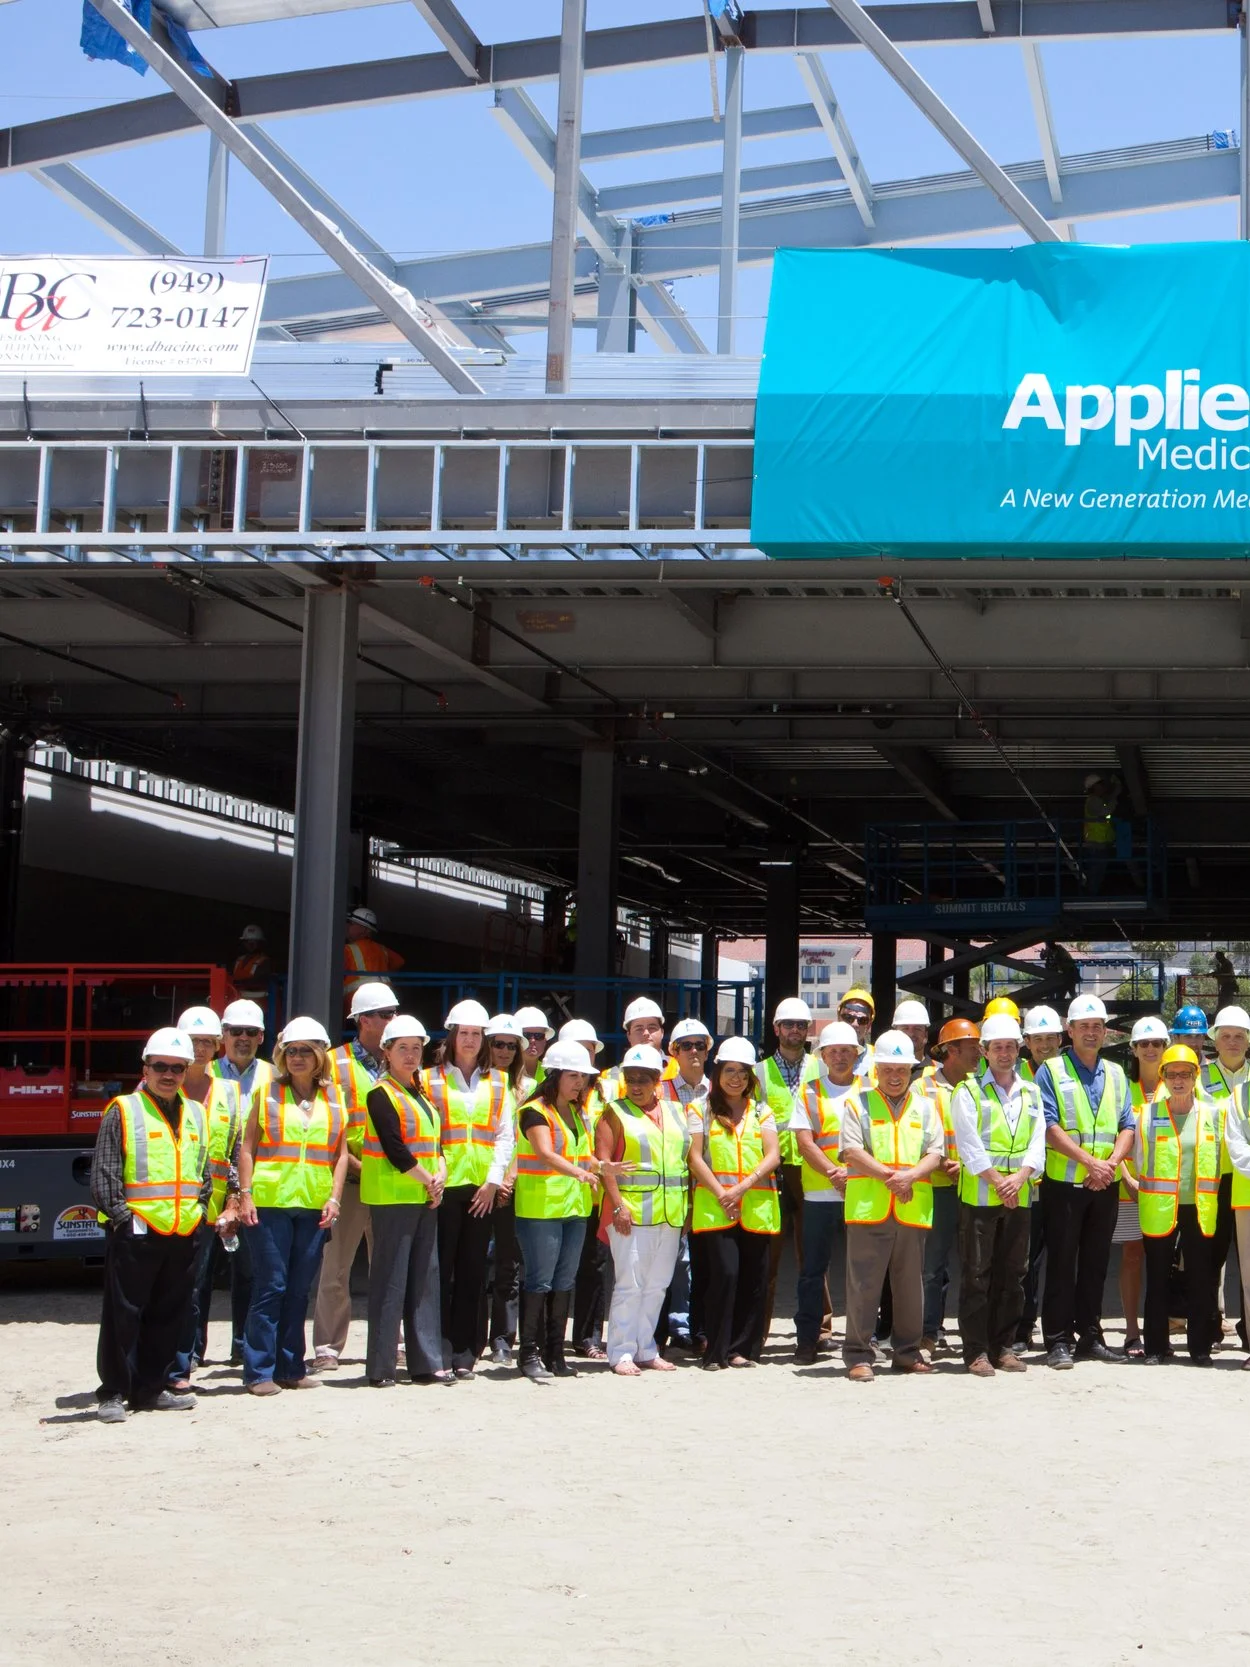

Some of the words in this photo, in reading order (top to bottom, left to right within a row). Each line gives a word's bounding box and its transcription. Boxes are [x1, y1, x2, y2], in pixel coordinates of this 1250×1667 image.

[150, 271, 224, 295] (949)
[110, 306, 249, 328] 723-0147
[106, 341, 239, 352] www.dbacinc.com
[124, 357, 167, 366] License
[1000, 488, 1016, 508] A
[1022, 488, 1074, 508] New
[1079, 488, 1206, 509] Generation
[935, 903, 977, 914] SUMMIT
[981, 901, 1026, 913] RENTALS
[9, 1085, 64, 1094] HILTI
